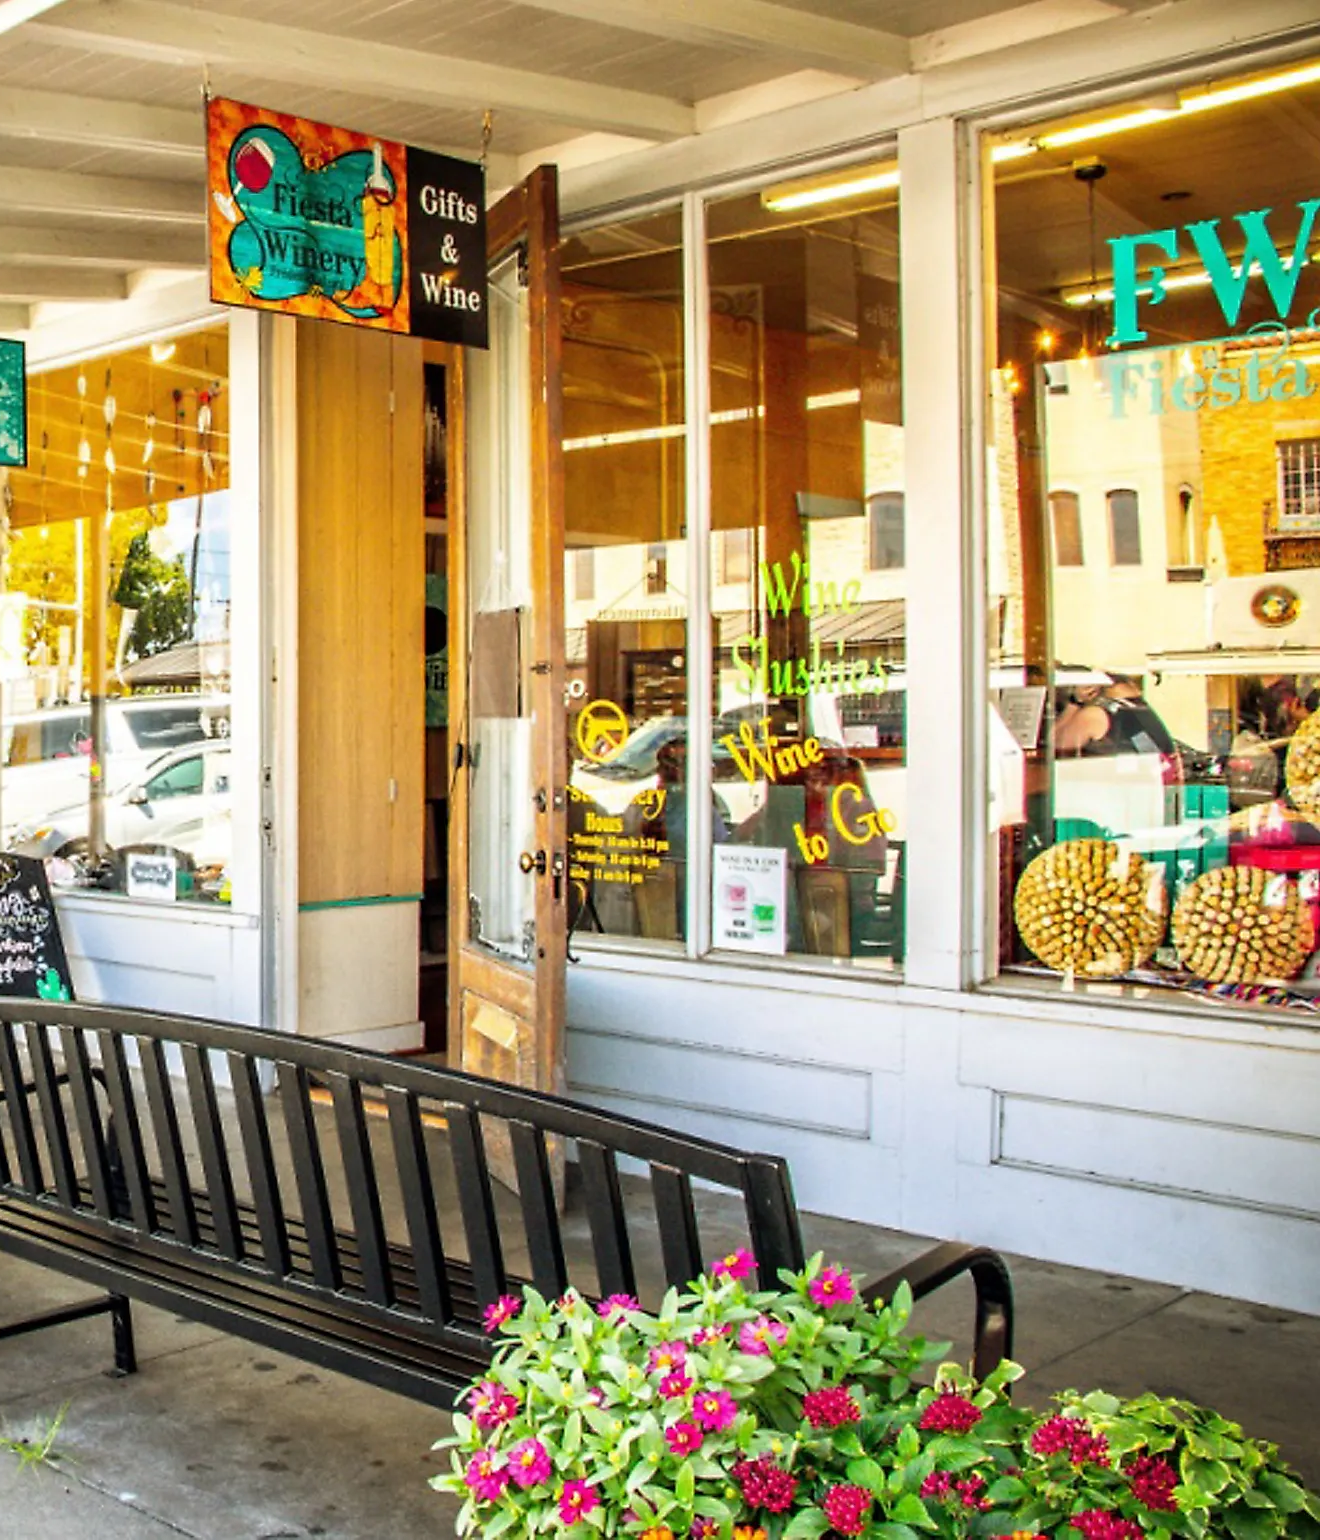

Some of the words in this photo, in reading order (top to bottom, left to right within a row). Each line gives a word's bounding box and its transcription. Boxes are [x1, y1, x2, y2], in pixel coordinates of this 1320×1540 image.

[273, 183, 353, 229] Fiesta
[420, 185, 478, 225] Gifts
[264, 230, 367, 279] Winery
[440, 233, 461, 265] &
[420, 272, 481, 312] Wine
[1107, 349, 1318, 419] Fiesta
[759, 551, 862, 619] Wine
[732, 634, 889, 696] Slushies
[718, 716, 824, 785] Wine
[793, 822, 829, 864] to
[831, 782, 898, 845] Go
